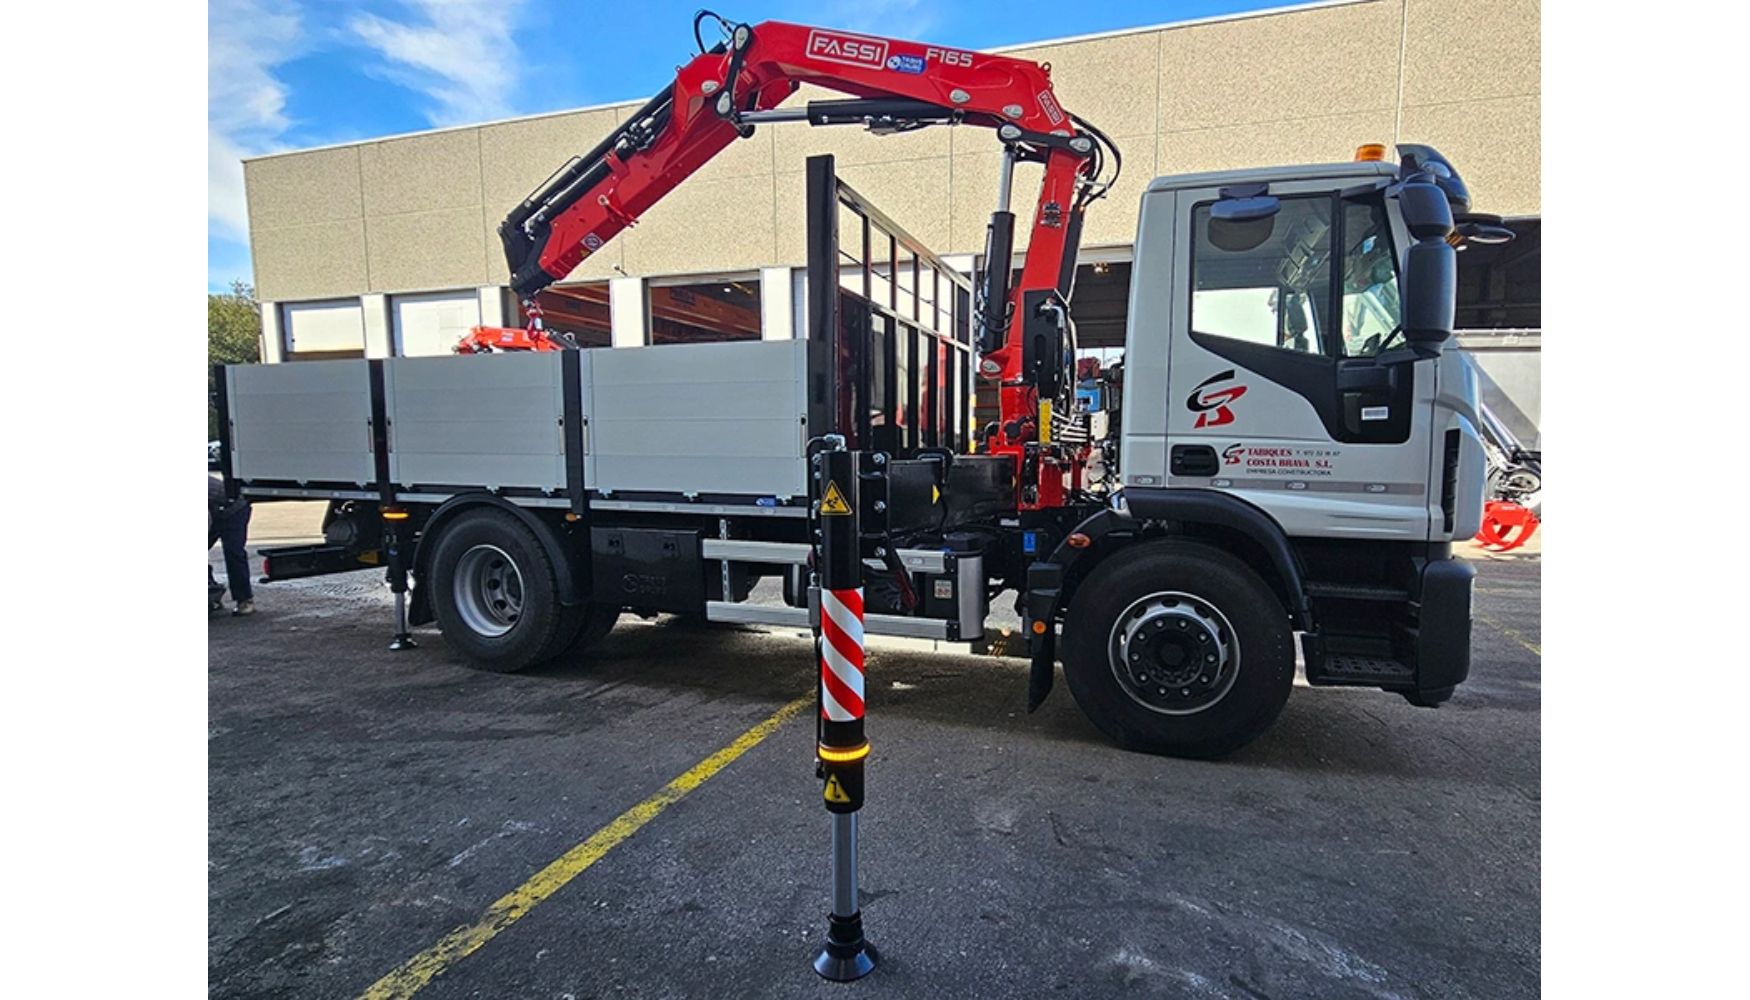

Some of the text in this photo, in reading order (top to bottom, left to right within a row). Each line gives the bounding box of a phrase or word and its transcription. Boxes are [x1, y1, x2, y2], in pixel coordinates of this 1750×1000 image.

[813, 36, 881, 62] FASSI
[925, 48, 973, 67] F165
[1248, 448, 1292, 457] TABIQUES
[1247, 458, 1276, 467] COSTA
[1279, 458, 1310, 468] BRAVA
